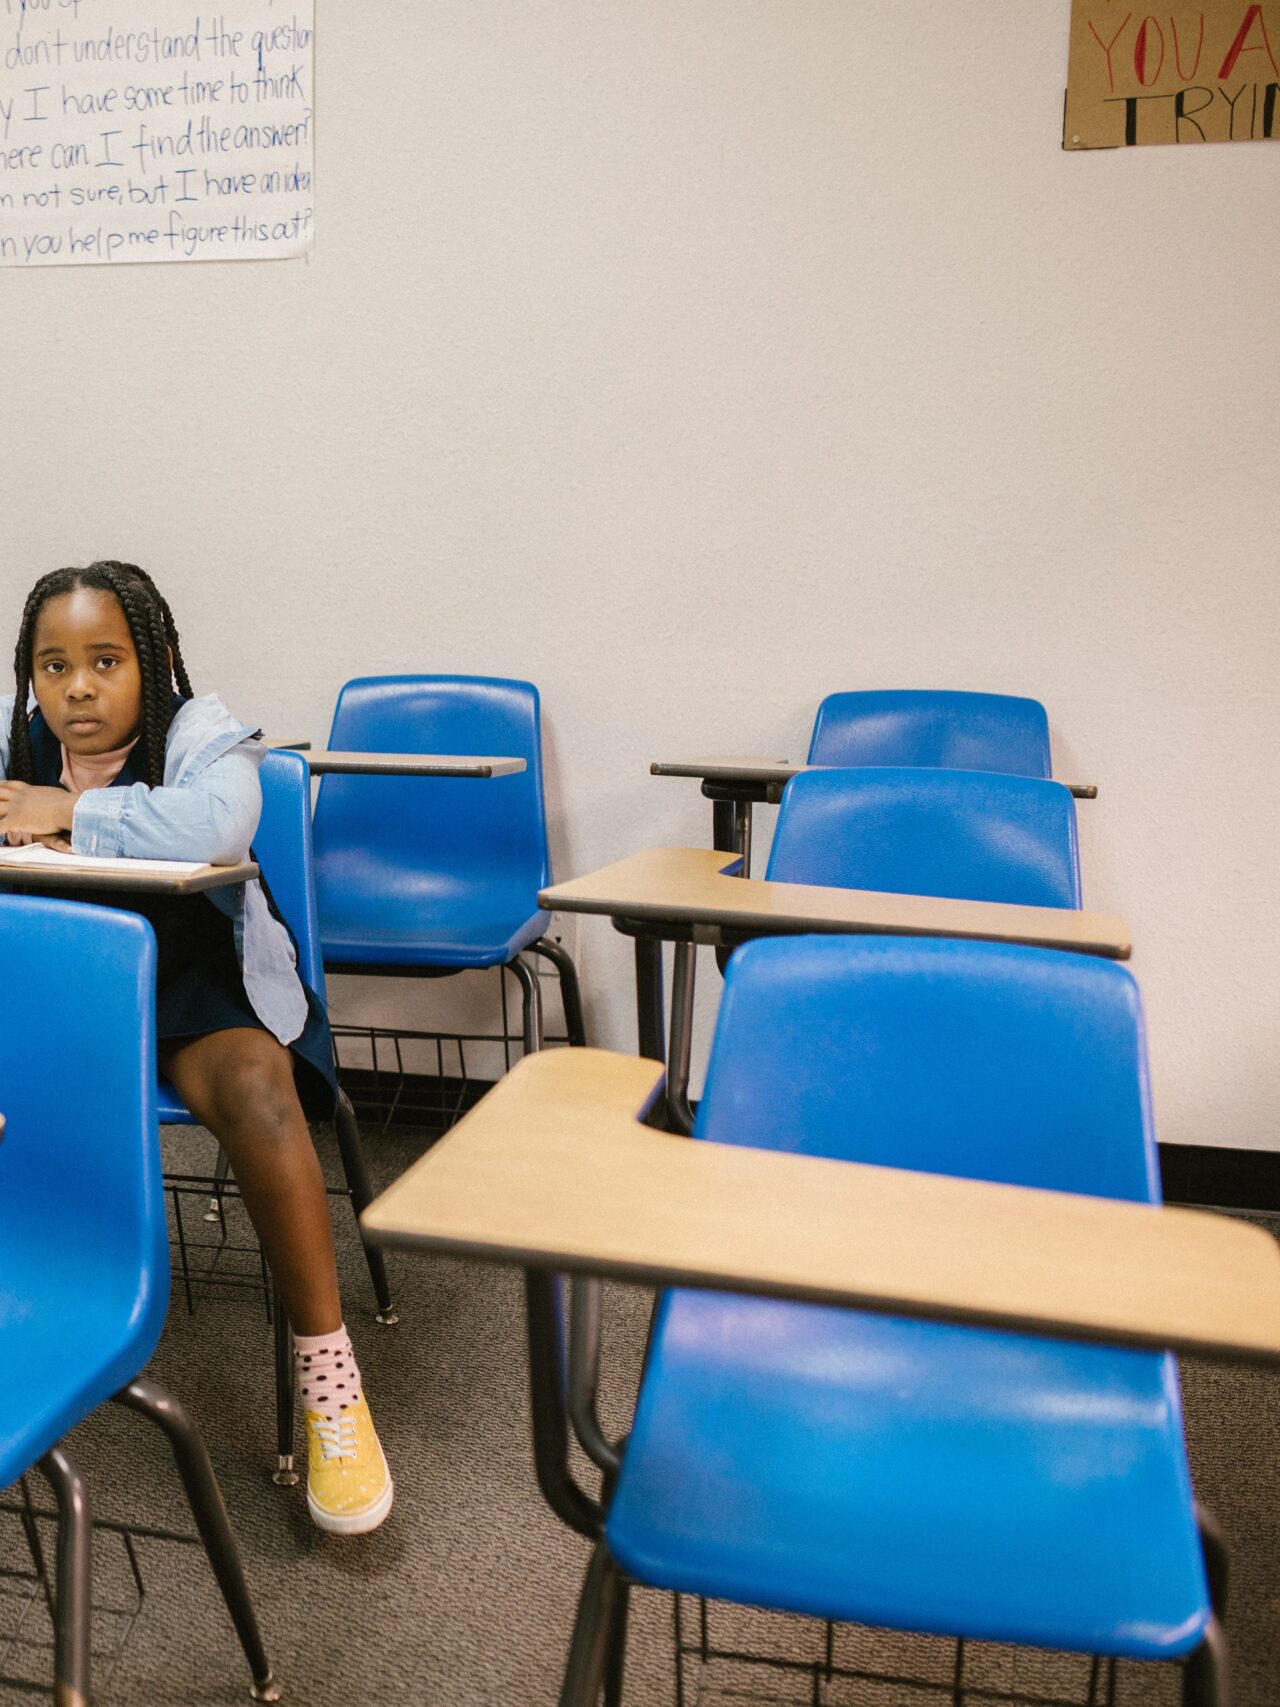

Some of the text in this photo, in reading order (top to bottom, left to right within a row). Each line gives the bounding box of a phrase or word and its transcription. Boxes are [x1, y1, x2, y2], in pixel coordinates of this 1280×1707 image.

[73, 16, 200, 63] understand
[206, 15, 244, 57] the
[1087, 12, 1204, 94] YOU
[23, 86, 51, 121] I
[62, 84, 120, 114] have
[124, 86, 175, 112] some
[177, 70, 225, 105] time
[230, 71, 250, 104] to
[50, 143, 89, 169] can
[94, 130, 126, 168] I
[131, 123, 194, 176] find
[196, 115, 232, 154] the
[22, 183, 62, 209] not
[127, 175, 169, 206] but
[174, 168, 199, 202] I
[203, 168, 257, 197] have
[260, 170, 282, 195] an
[22, 233, 63, 263] you
[68, 226, 125, 262] help
[128, 228, 160, 246] me
[162, 209, 229, 257] figure
[231, 215, 269, 244] this
